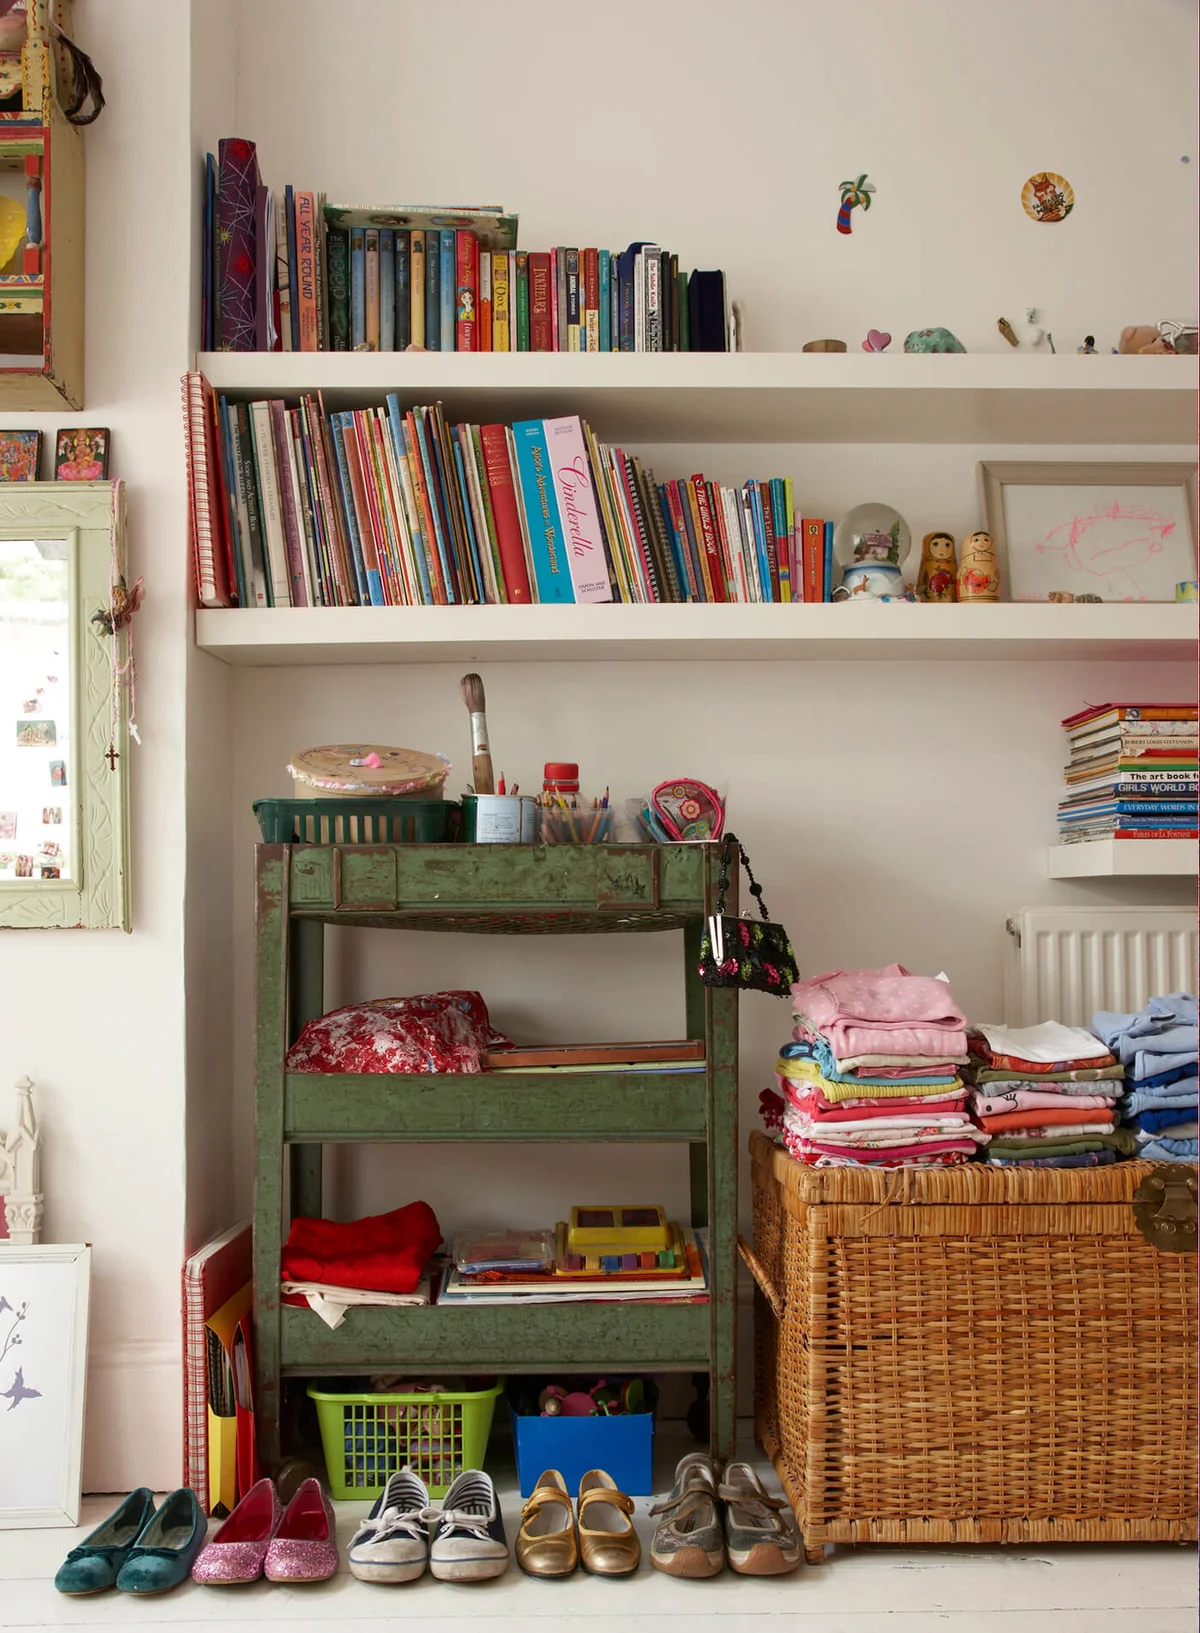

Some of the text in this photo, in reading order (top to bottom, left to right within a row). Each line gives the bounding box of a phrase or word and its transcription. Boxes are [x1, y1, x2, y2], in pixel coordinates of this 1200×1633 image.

[299, 196, 310, 215] ALL
[301, 220, 312, 253] YEAR
[302, 258, 313, 299] ROUND
[534, 268, 547, 314] INKHEART
[531, 446, 543, 472] Alice's
[536, 472, 550, 518] Adventures
[557, 455, 594, 558] Cinderella
[696, 488, 706, 506] THE
[704, 531, 717, 556] BOOK
[764, 521, 773, 543] Lottie
[543, 526, 560, 574] Wonderland
[767, 544, 776, 573] Project
[1118, 784, 1148, 792] GIRLS'
[1150, 784, 1187, 792] WORLD
